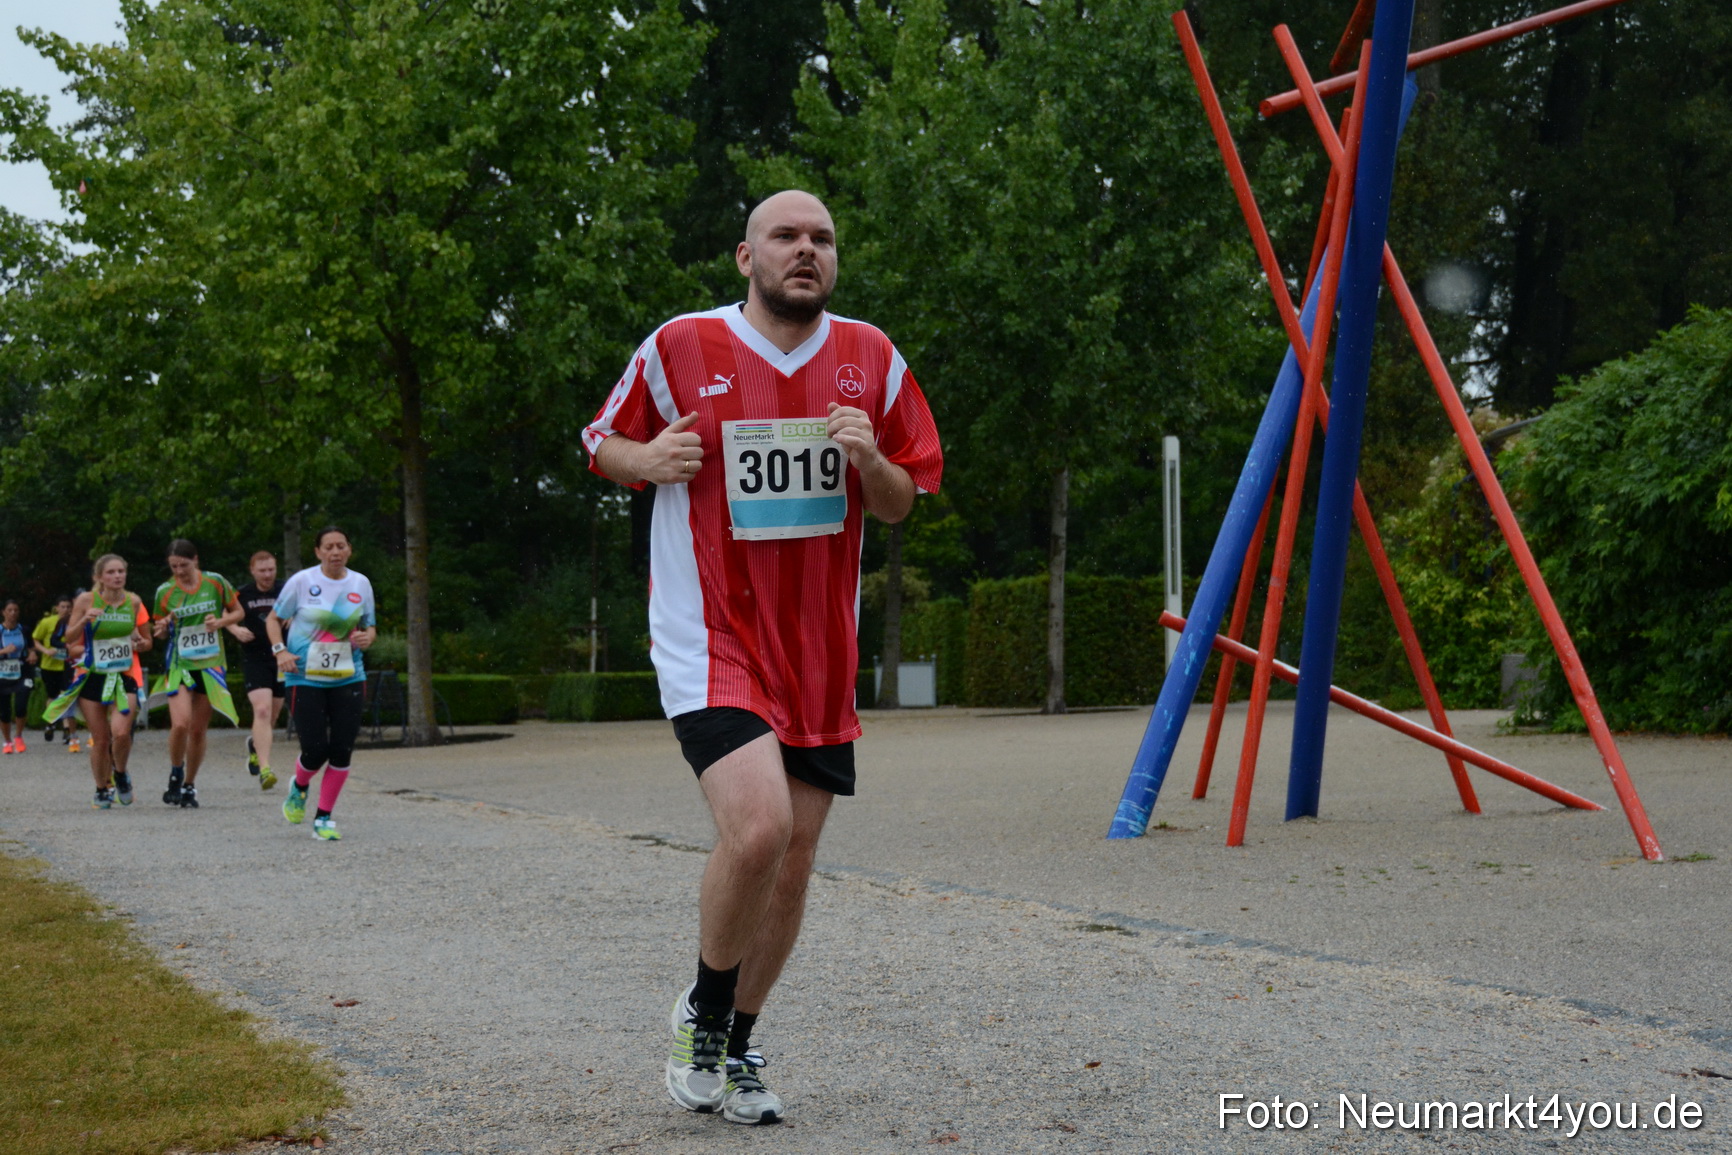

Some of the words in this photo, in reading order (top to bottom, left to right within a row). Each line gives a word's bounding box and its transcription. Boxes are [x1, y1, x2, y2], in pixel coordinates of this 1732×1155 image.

[840, 379, 862, 392] FCN
[733, 433, 775, 441] NeuerMarkt
[782, 423, 829, 438] BOC
[739, 447, 841, 494] 3019
[182, 631, 216, 648] 2878
[99, 644, 130, 661] 2830
[321, 653, 340, 669] 37
